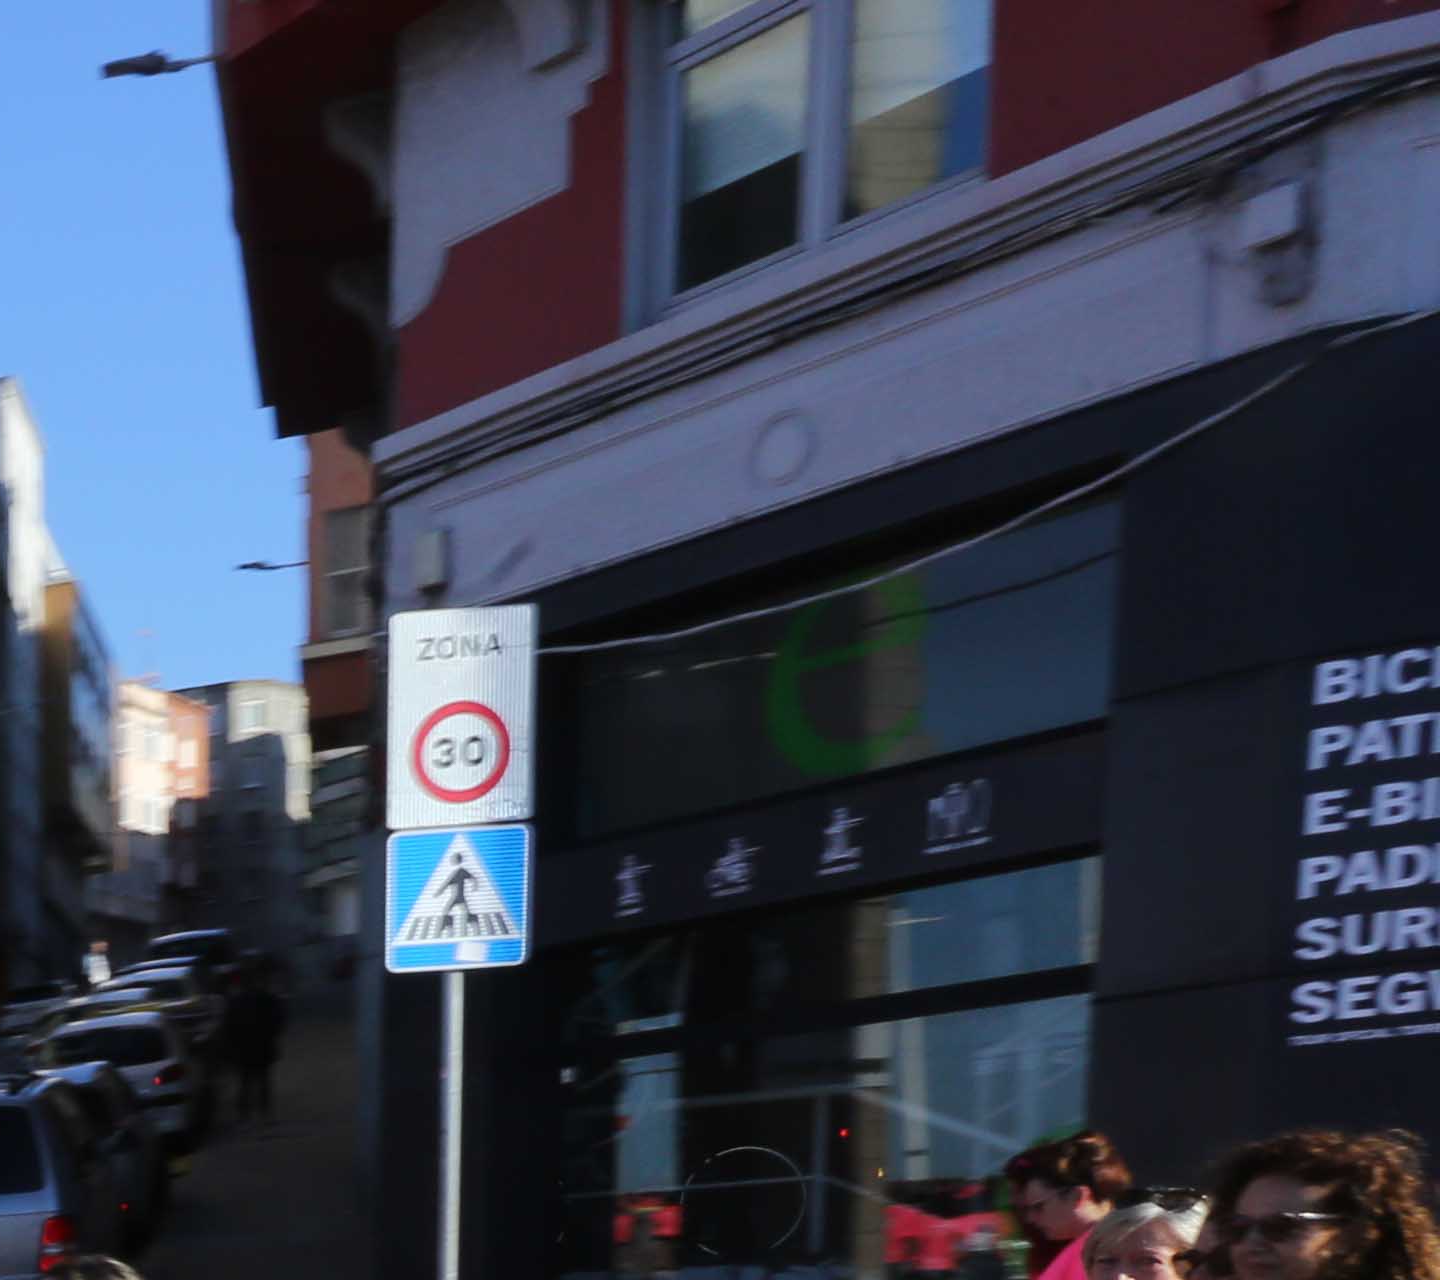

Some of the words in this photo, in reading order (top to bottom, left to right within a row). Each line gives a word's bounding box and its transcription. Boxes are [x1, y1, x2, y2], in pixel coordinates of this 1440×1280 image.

[416, 633, 502, 662] ZONA
[431, 736, 485, 768] 30
[1288, 968, 1440, 1024] SEG
